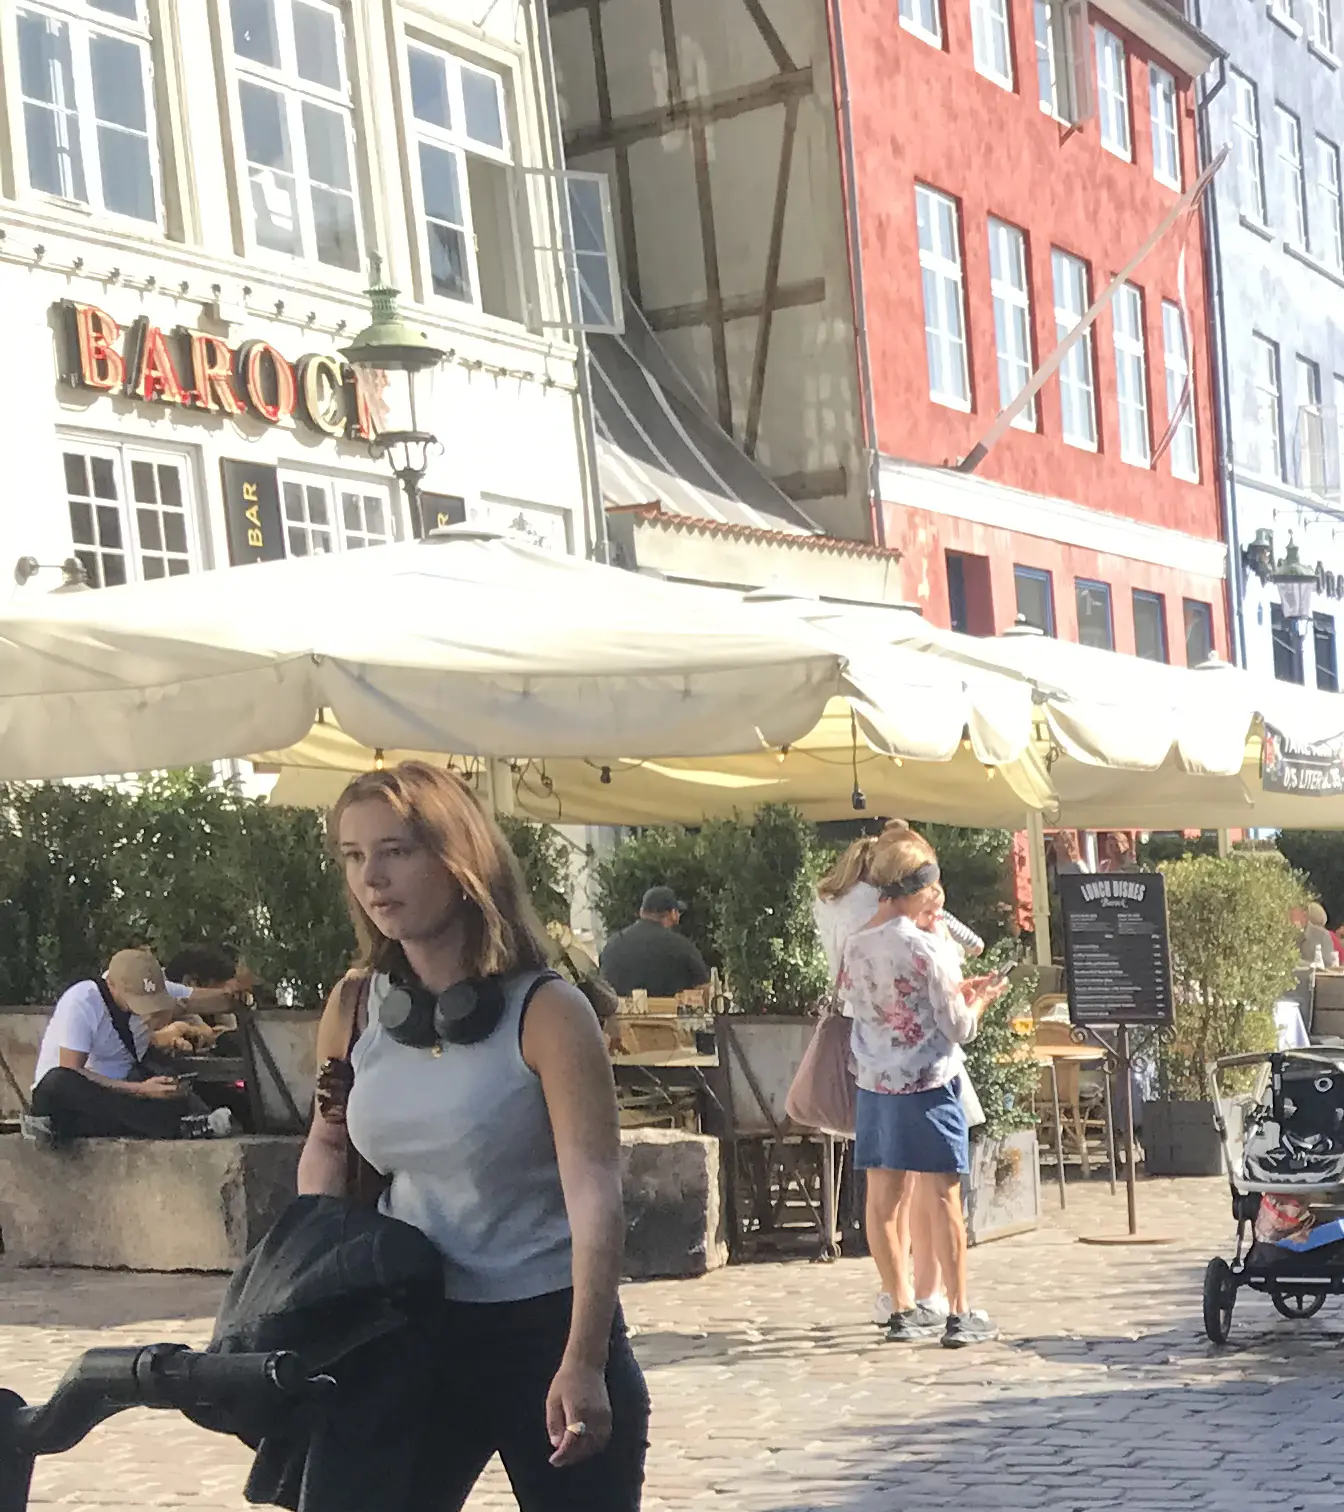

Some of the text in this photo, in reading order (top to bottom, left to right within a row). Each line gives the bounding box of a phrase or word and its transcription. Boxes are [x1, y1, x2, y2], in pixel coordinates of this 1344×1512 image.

[244, 481, 263, 548] BAR
[1081, 881, 1146, 902] LUNCH DISHES
